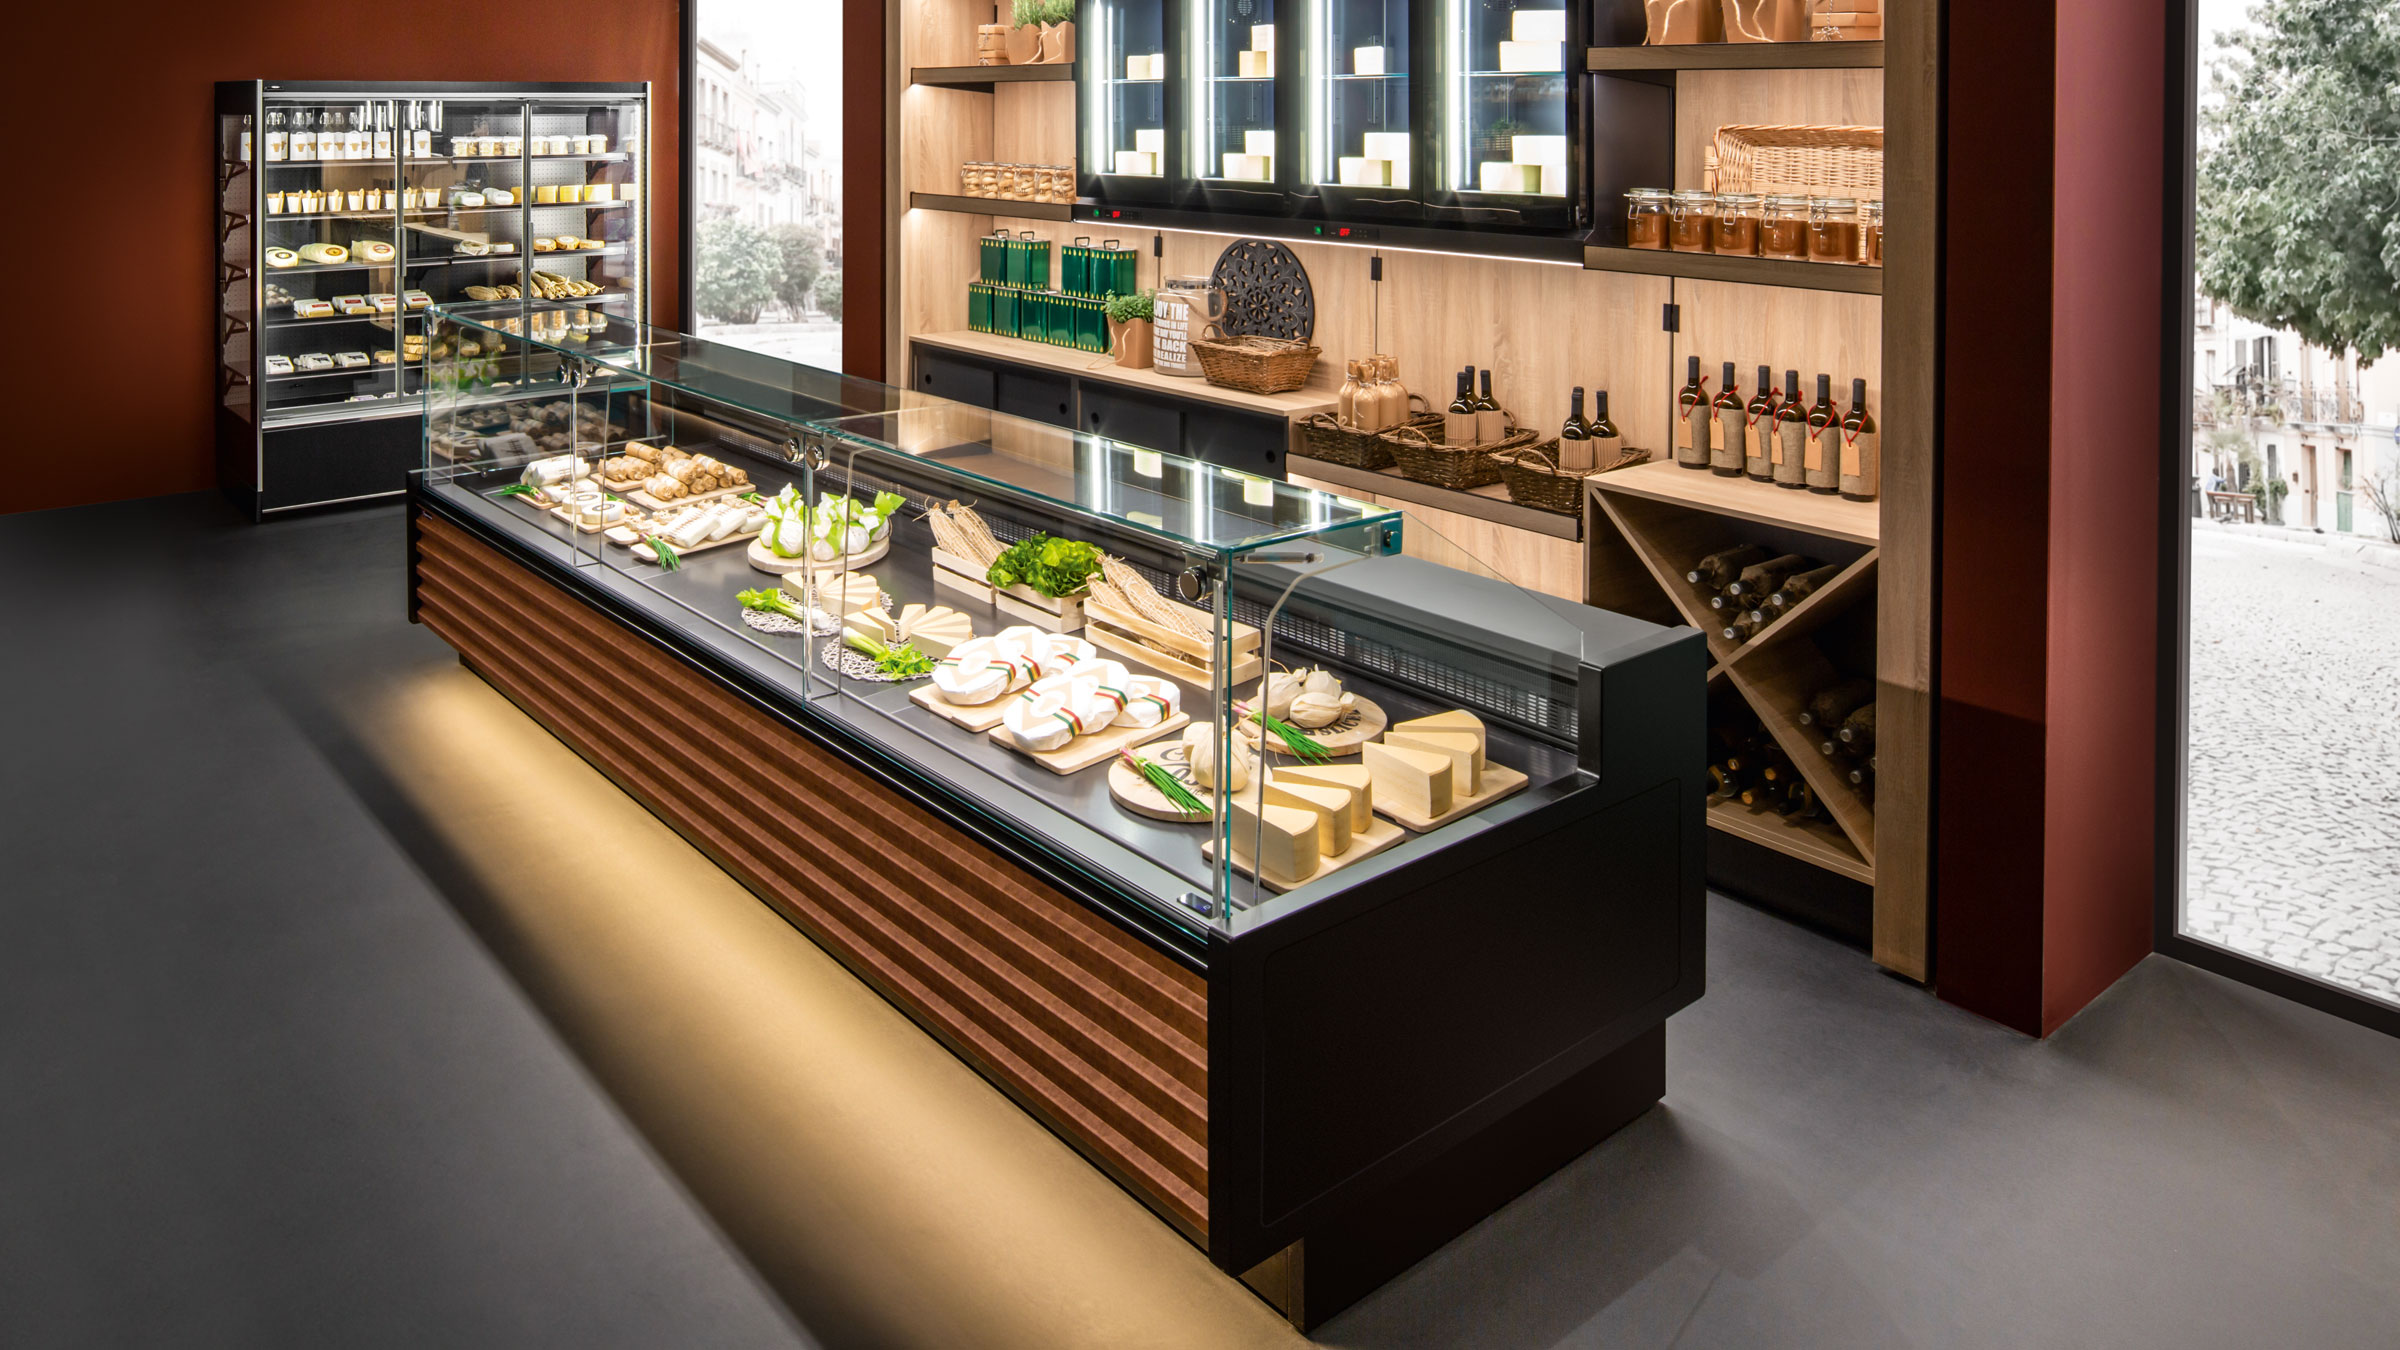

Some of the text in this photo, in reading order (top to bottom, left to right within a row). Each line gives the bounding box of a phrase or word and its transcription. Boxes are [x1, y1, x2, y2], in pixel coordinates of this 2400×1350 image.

[1170, 303, 1189, 321] THE
[1161, 338, 1187, 353] BACK
[1157, 349, 1187, 363] REALIZE
